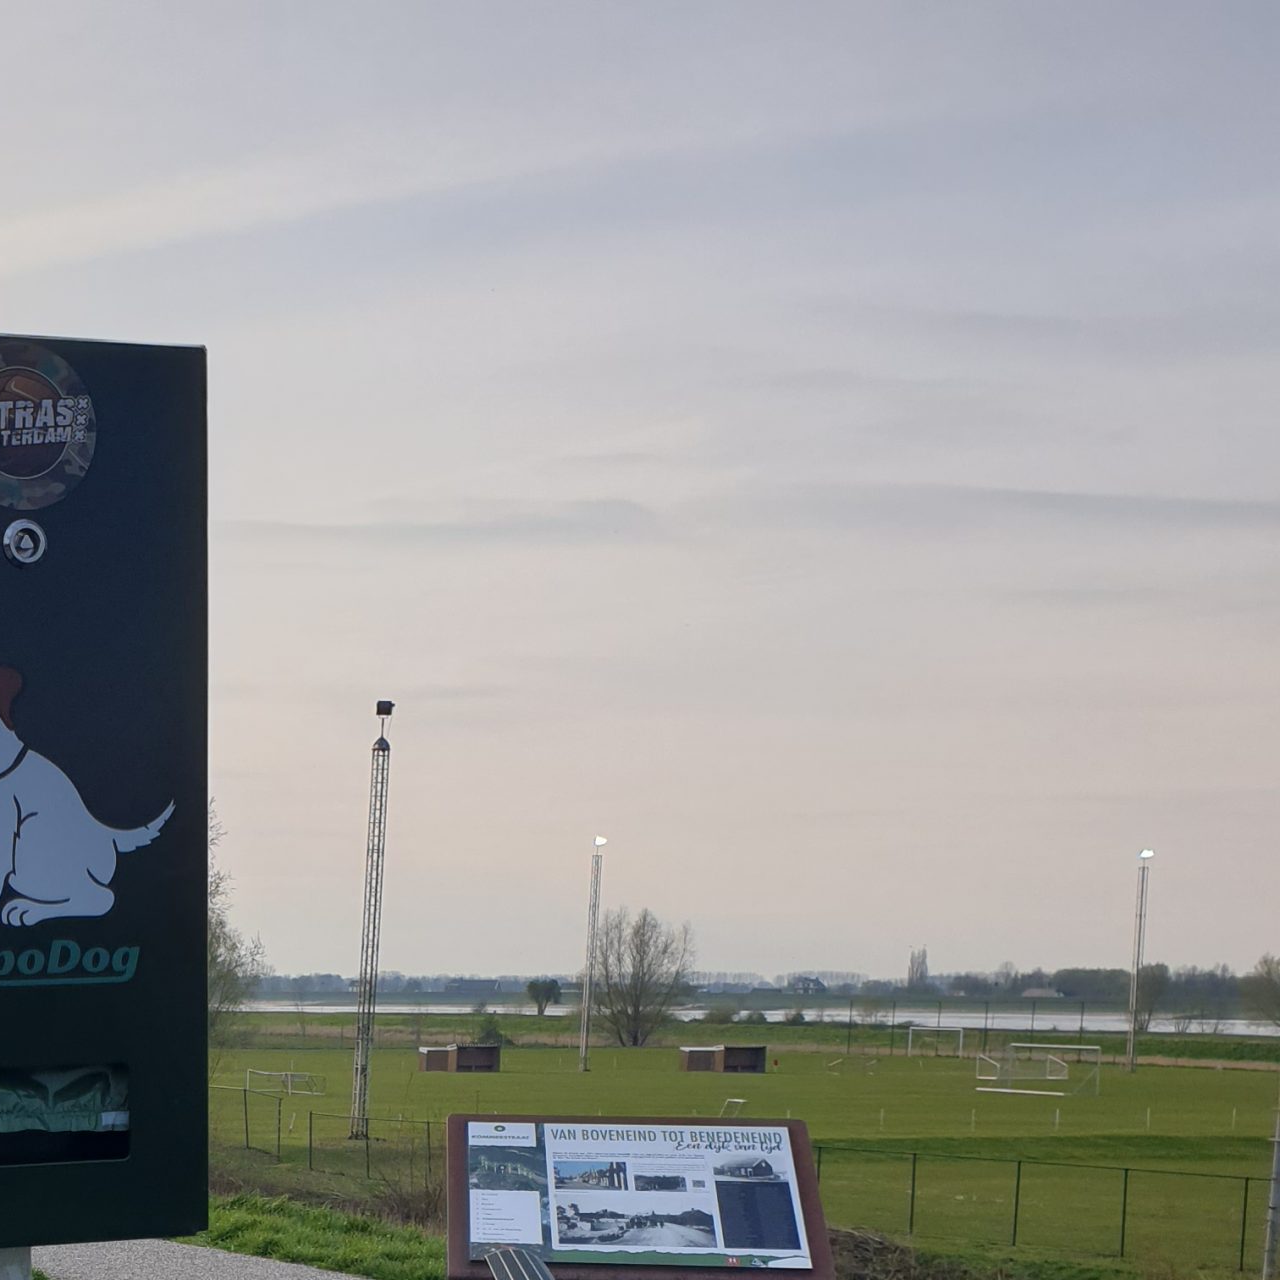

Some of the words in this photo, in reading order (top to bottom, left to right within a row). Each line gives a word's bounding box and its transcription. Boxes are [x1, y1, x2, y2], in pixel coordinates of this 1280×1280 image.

[551, 1128, 577, 1140] VAN
[581, 1129, 657, 1142] BOVENEIND
[661, 1130, 685, 1142] TOT
[689, 1131, 783, 1144] BENEDENEIND
[675, 1141, 701, 1151] Een
